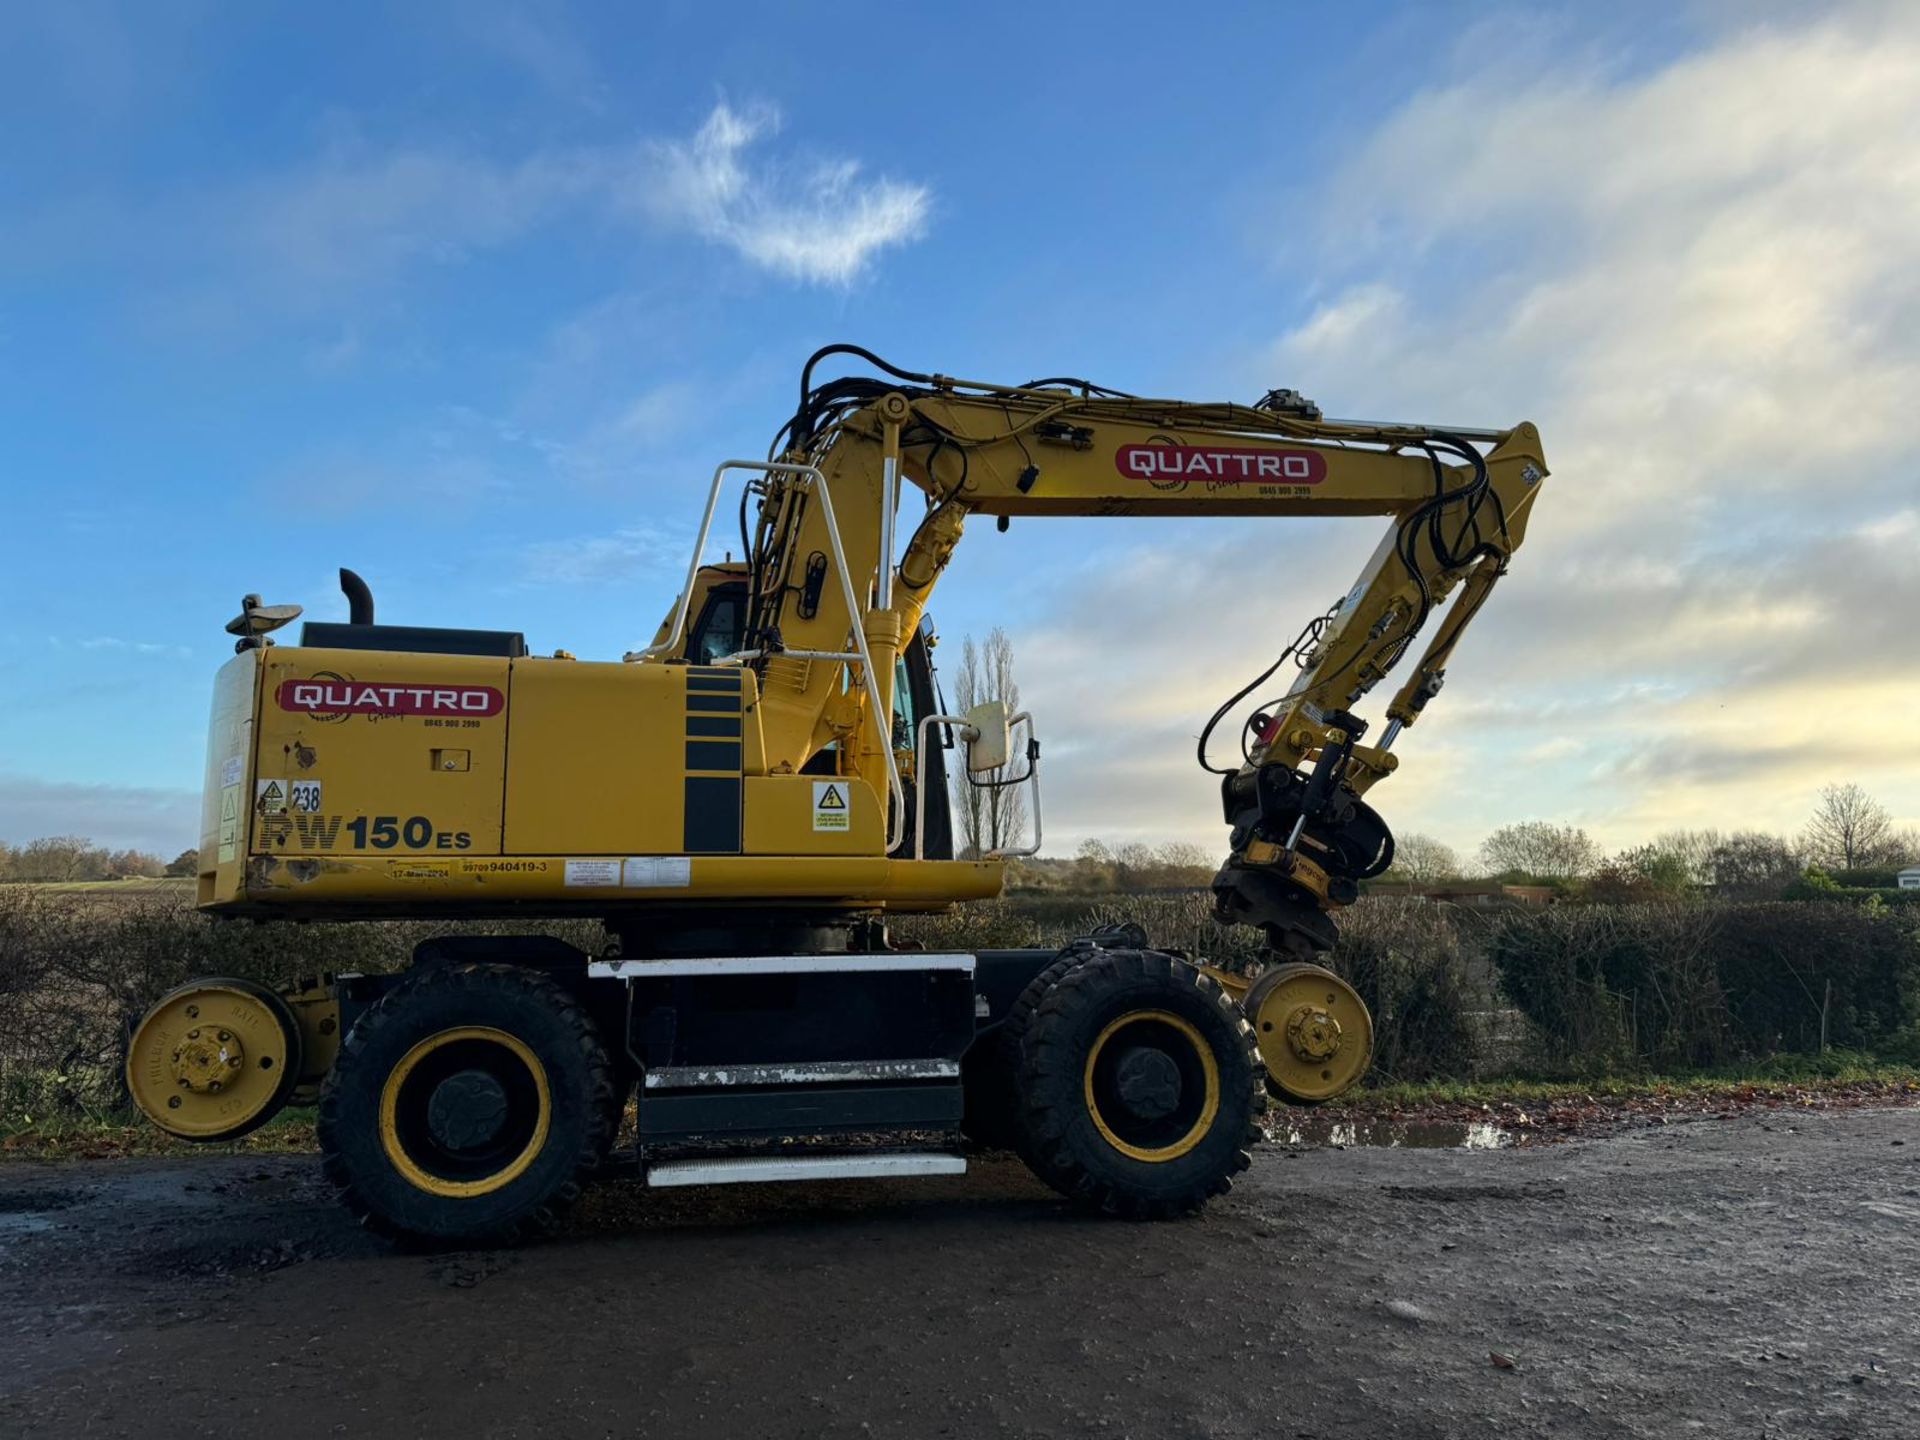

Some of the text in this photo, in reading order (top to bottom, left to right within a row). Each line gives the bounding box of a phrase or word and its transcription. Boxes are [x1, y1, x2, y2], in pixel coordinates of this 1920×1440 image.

[1128, 450, 1309, 478] QUATTRO
[293, 684, 490, 711] QUATTRO
[292, 787, 320, 812] 238
[490, 861, 548, 873] 940419-3
